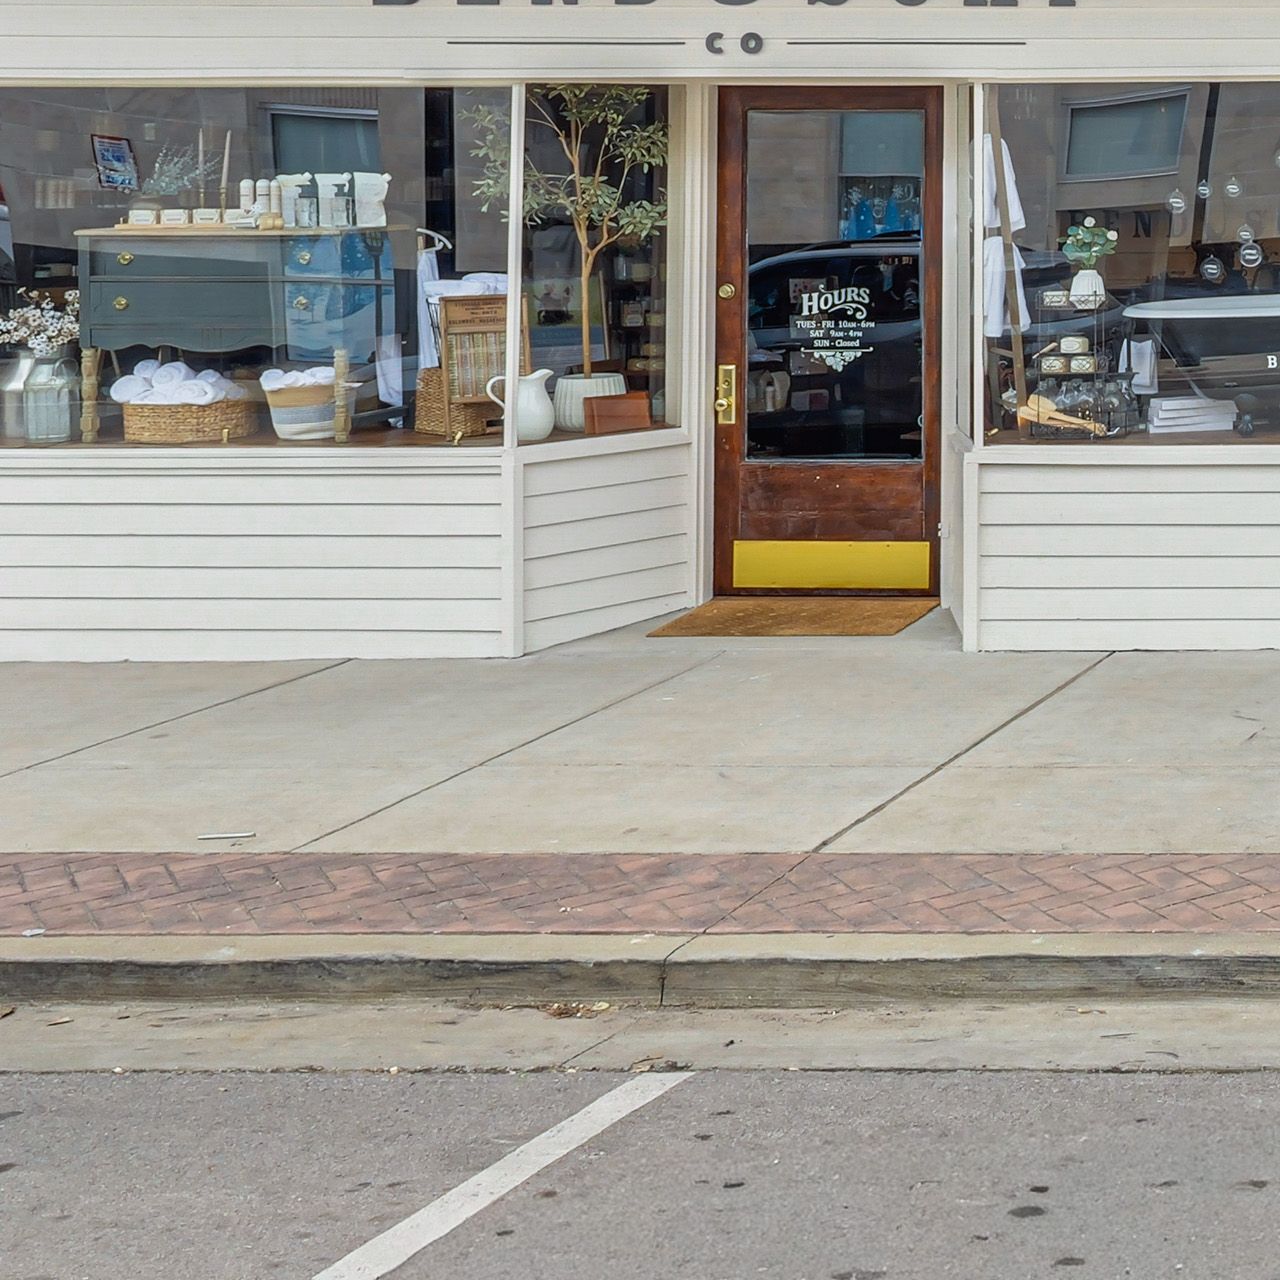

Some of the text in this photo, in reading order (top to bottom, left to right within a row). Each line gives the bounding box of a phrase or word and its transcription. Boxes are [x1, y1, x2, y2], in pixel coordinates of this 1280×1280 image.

[704, 31, 765, 55] CO
[796, 320, 816, 328] TUES
[821, 320, 835, 328] FRI
[813, 339, 830, 347] SUN
[835, 339, 860, 347] Closed
